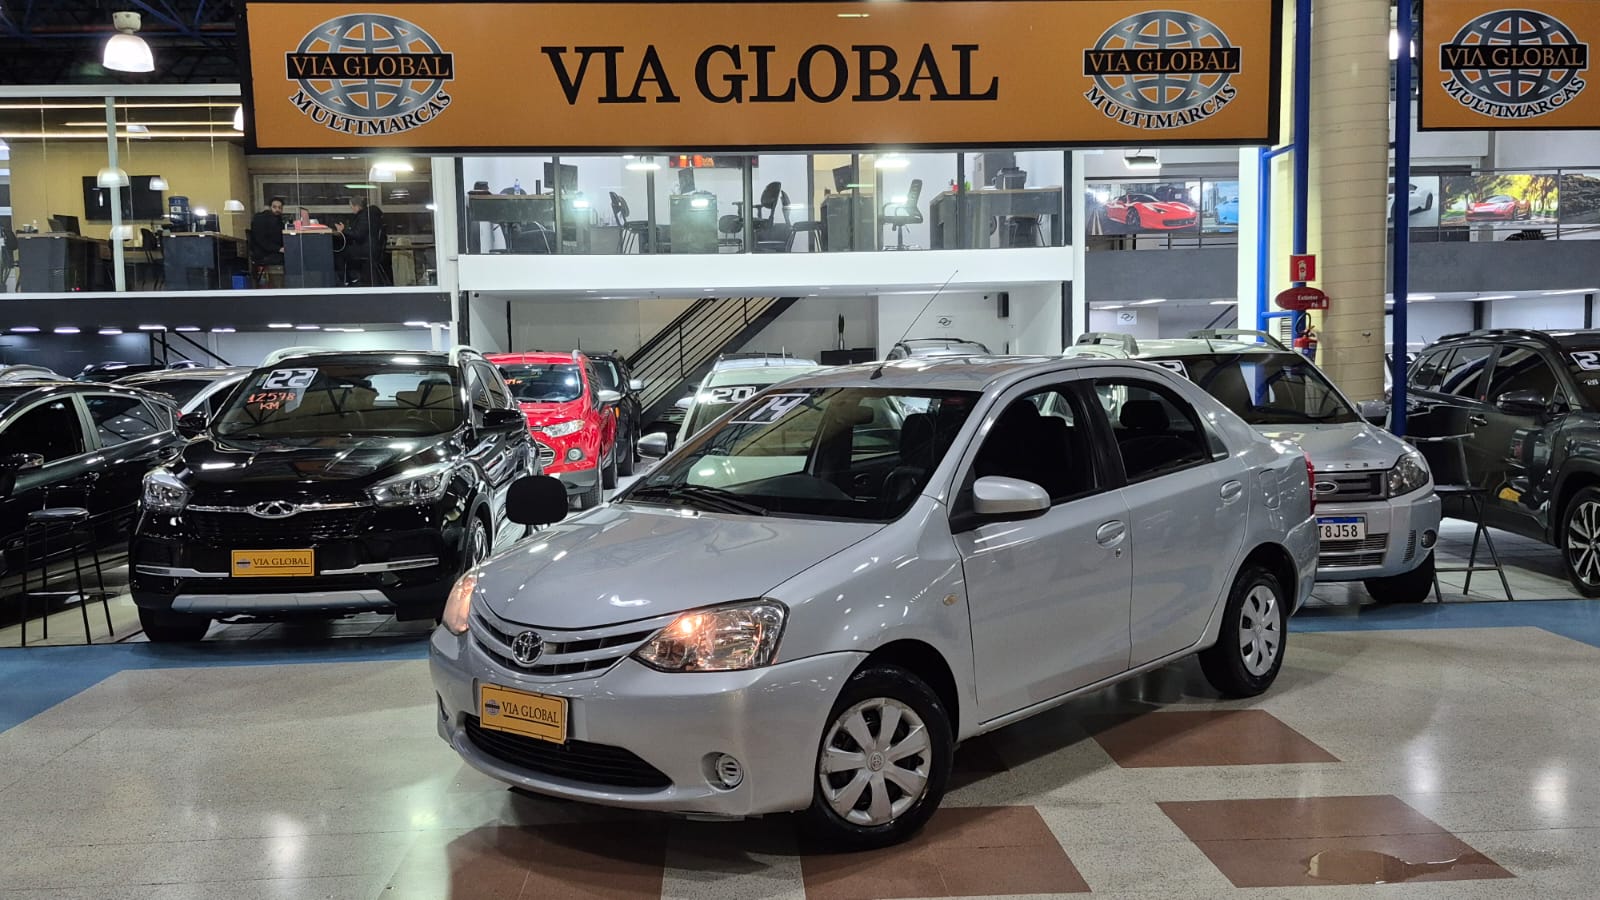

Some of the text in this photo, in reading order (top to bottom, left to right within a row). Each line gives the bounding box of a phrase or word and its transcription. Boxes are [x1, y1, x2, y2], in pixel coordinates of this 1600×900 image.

[290, 56, 450, 77] VIA GLOBAL
[1088, 51, 1238, 72] VIA GLOBAL
[1445, 47, 1585, 67] VIA GLOBAL
[541, 43, 999, 105] VIA GLOBAL
[1085, 84, 1236, 129] MULTIMARCAS
[1443, 77, 1586, 118] MULTIMARCAS
[290, 90, 452, 135] MULTIMARCAS
[267, 370, 314, 388] 22
[253, 557, 310, 566] VIA GLOBAL
[502, 701, 560, 724] VIA GLOBAL
